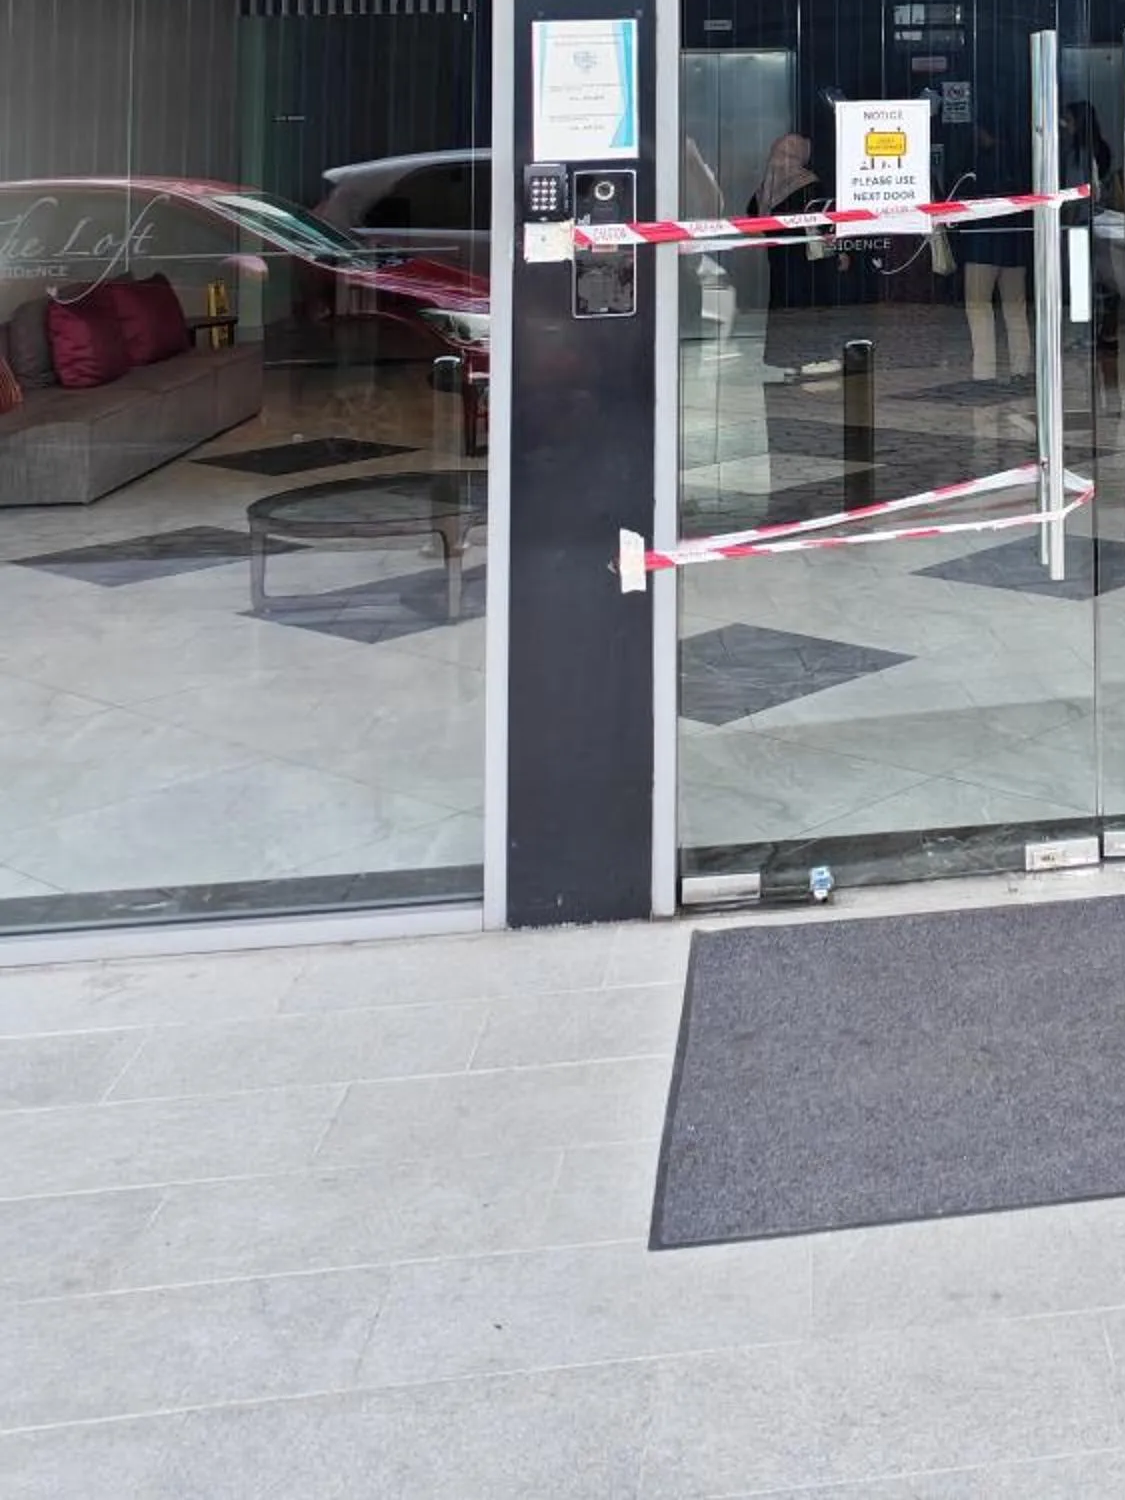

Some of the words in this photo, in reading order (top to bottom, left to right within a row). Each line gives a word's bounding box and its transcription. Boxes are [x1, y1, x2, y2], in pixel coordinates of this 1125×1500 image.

[863, 110, 904, 121] NOTICE
[851, 175, 893, 186] PLEASE
[895, 175, 917, 185] USE
[853, 192, 881, 201] NEXT
[883, 191, 916, 201] DOOR
[49, 194, 170, 304] Loft
